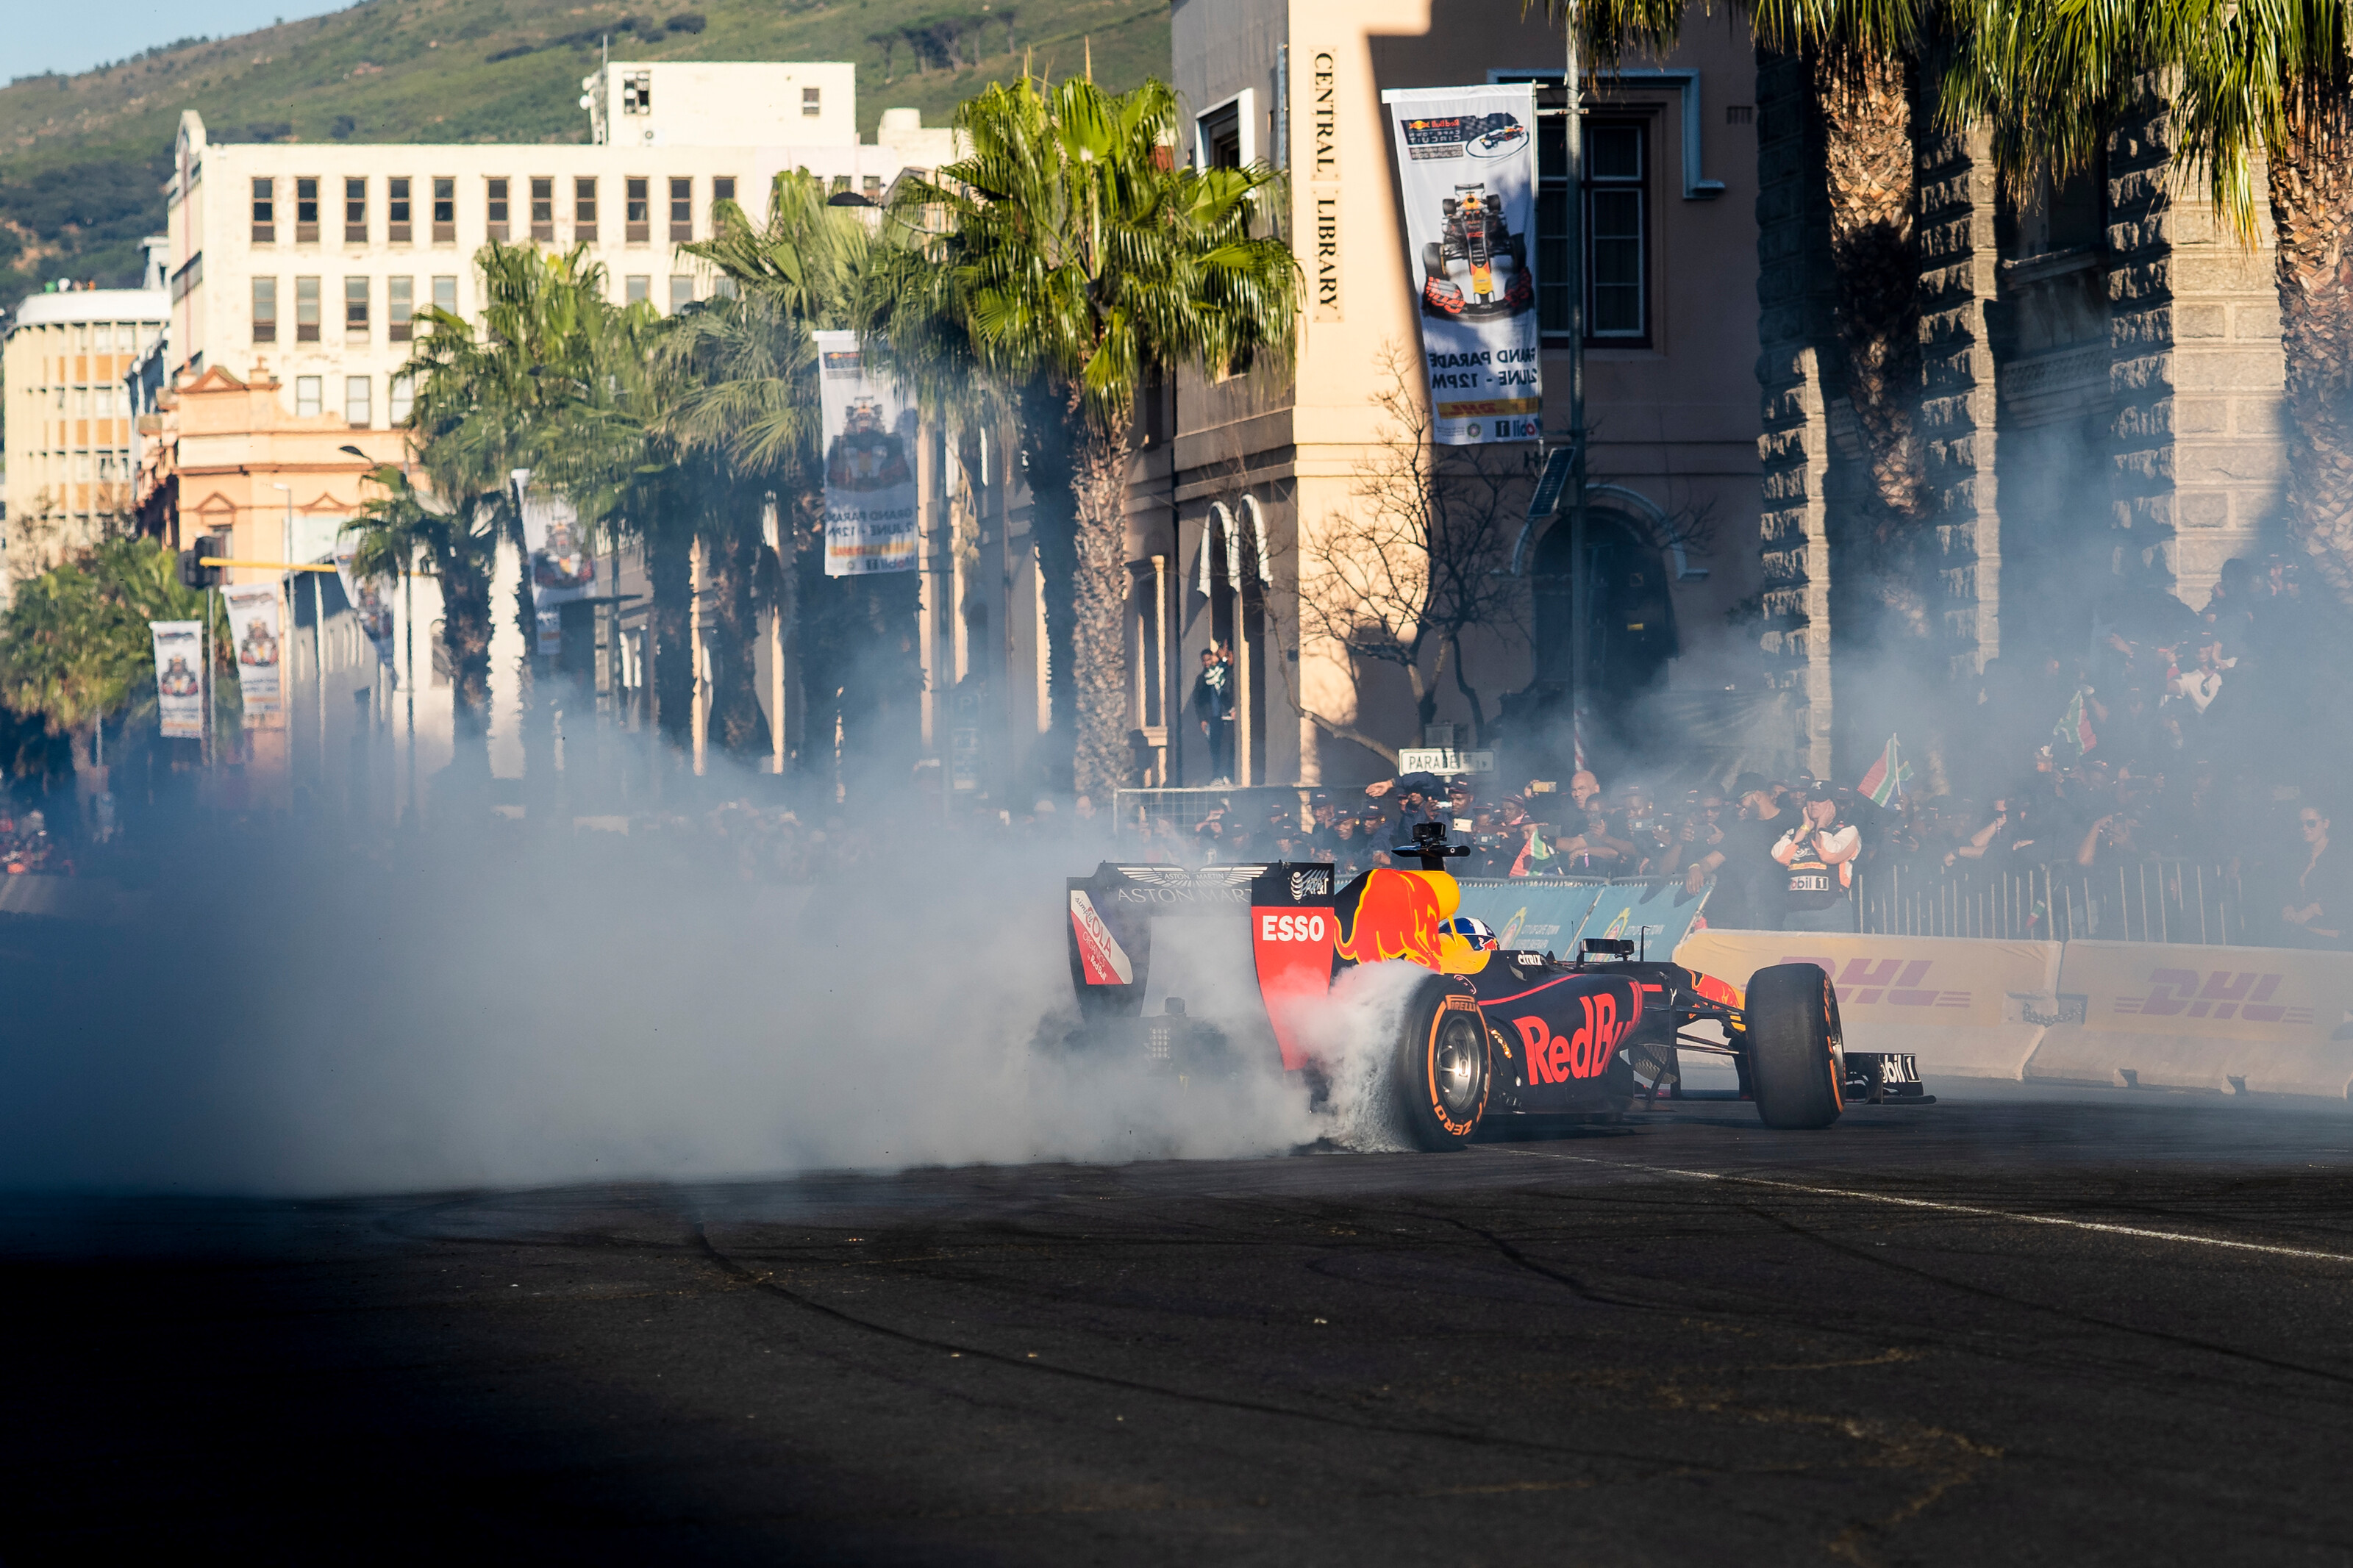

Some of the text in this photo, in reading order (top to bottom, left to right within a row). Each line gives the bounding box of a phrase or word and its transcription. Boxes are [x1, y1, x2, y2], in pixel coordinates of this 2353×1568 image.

[1314, 52, 1338, 311] CENTRAL LIBRARY
[1409, 756, 1458, 770] PARAE
[1164, 872, 1224, 881] ASTON MARTIN
[1790, 877, 1812, 889] obil
[1118, 888, 1195, 903] ASTON
[1085, 906, 1112, 959] COLA
[1262, 914, 1325, 942] ESSO
[1445, 994, 1477, 1012] PIRELLI
[2140, 967, 2288, 1023] DHL
[1512, 995, 1595, 1086] Red
[1882, 1054, 1906, 1083] bil
[1434, 1104, 1473, 1136] ZERO
